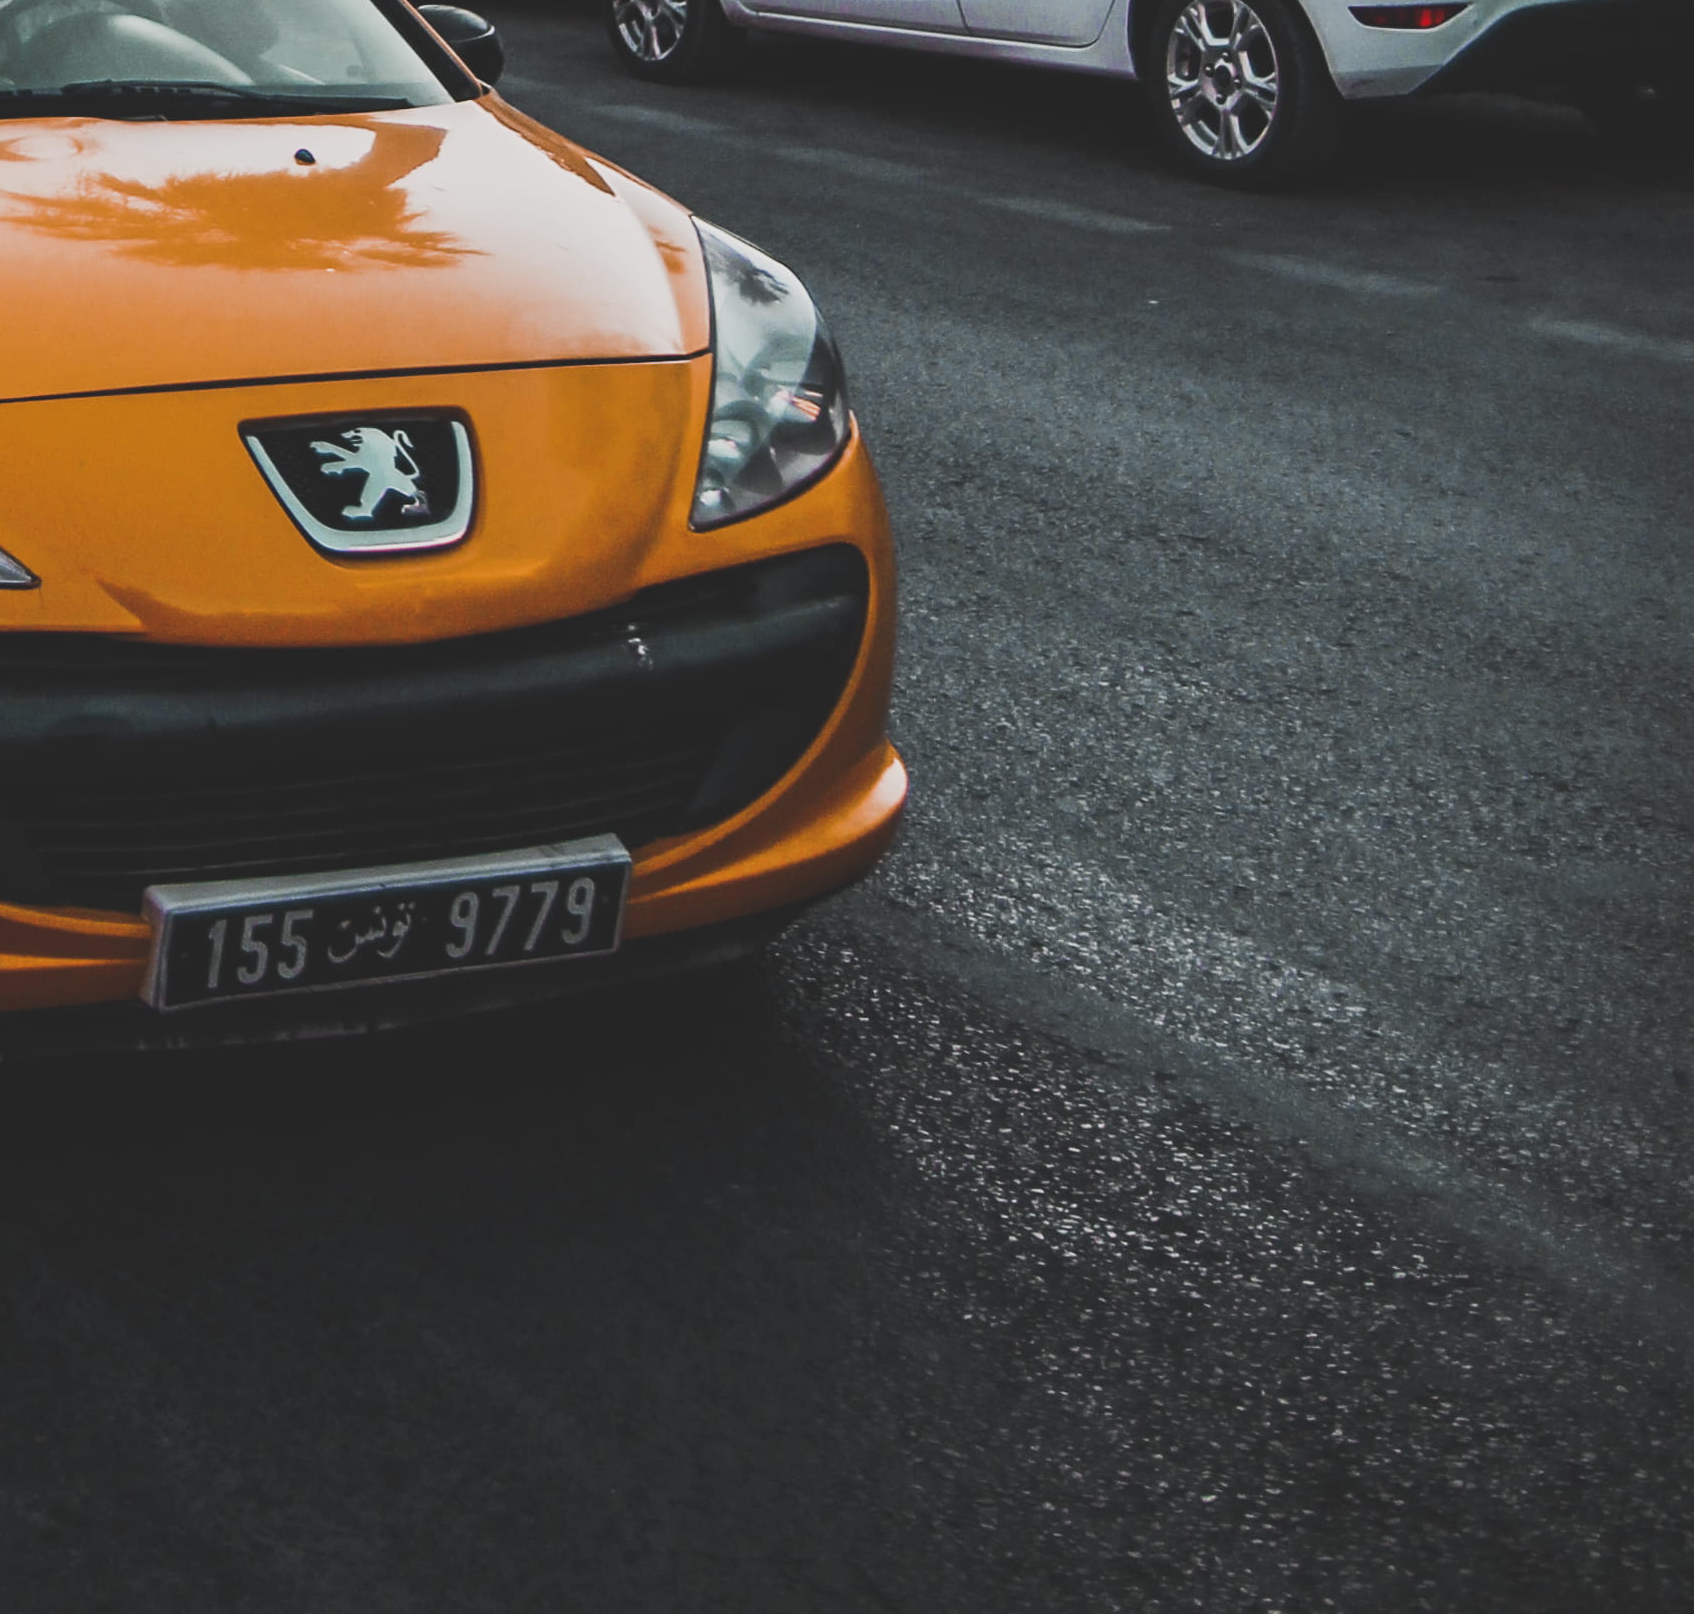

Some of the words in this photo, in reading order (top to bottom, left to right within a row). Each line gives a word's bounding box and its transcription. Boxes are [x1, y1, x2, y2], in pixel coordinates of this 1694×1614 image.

[206, 908, 316, 990] 155
[326, 899, 418, 964] تونس
[445, 876, 596, 960] 9779
